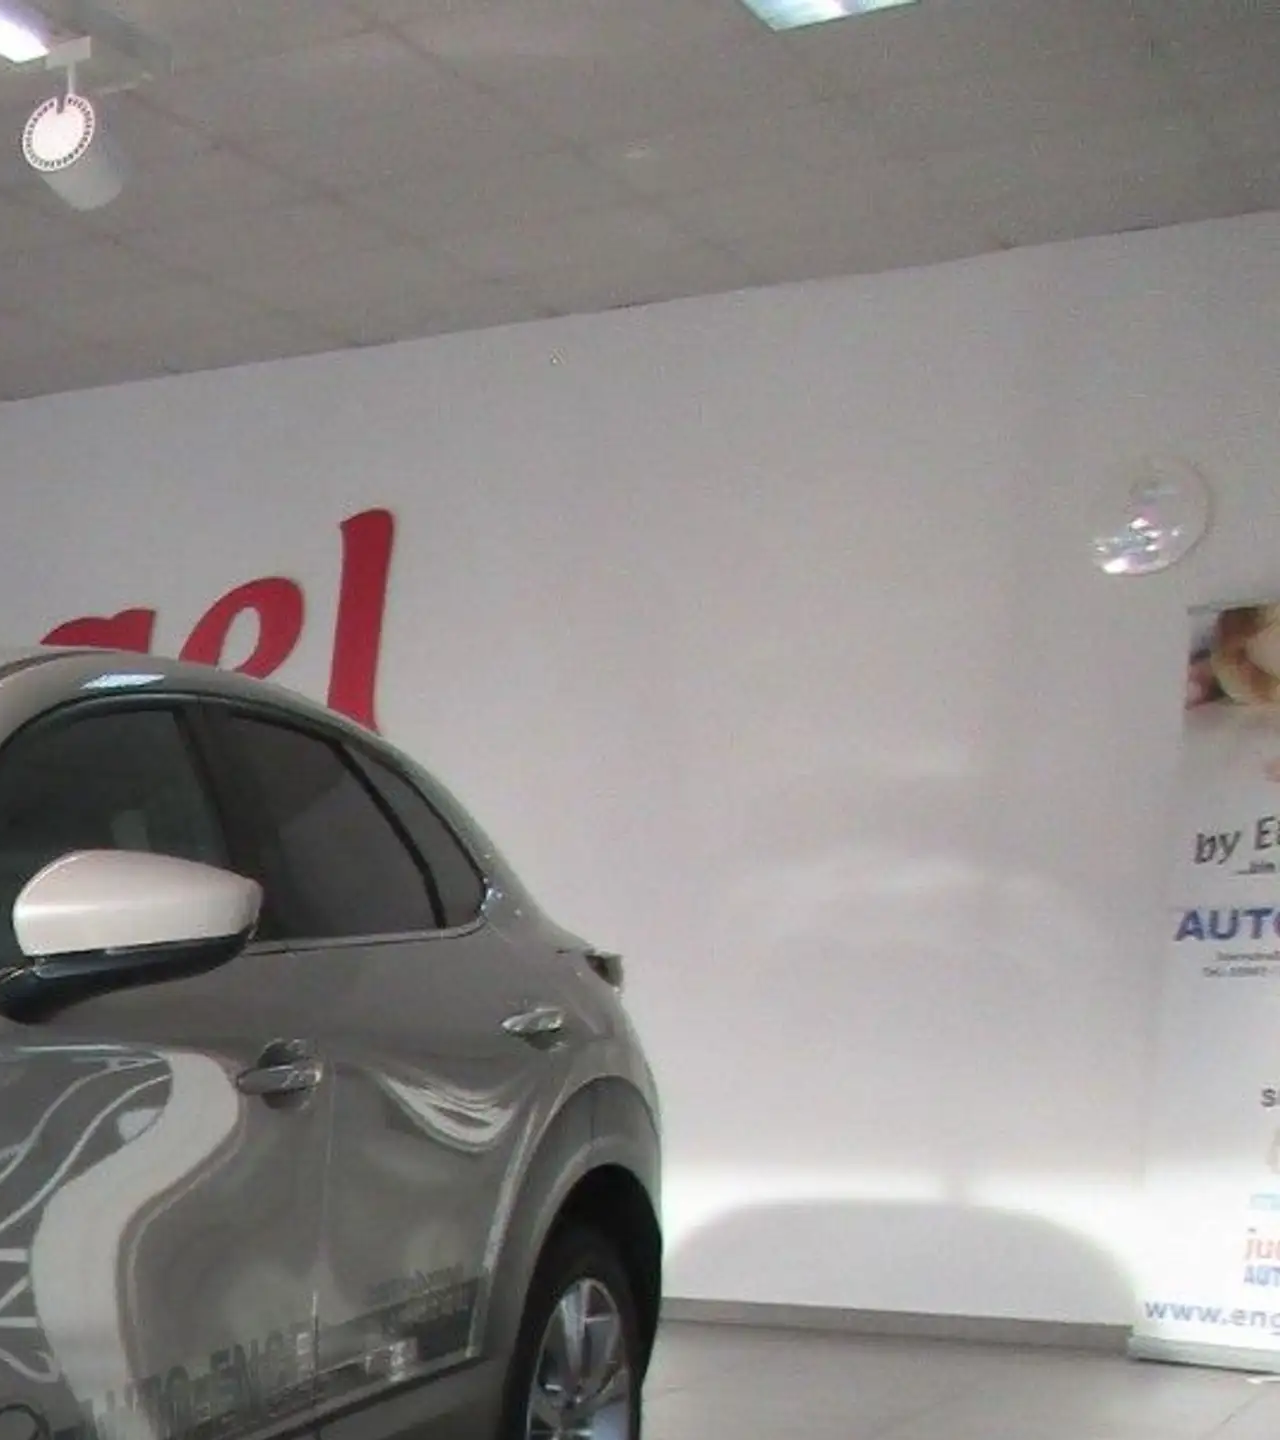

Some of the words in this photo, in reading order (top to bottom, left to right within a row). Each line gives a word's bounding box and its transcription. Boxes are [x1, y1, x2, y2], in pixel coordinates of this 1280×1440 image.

[1193, 829, 1242, 865] by
[1253, 814, 1280, 851] E
[1173, 907, 1280, 943] AUT
[1260, 1087, 1280, 1108] S
